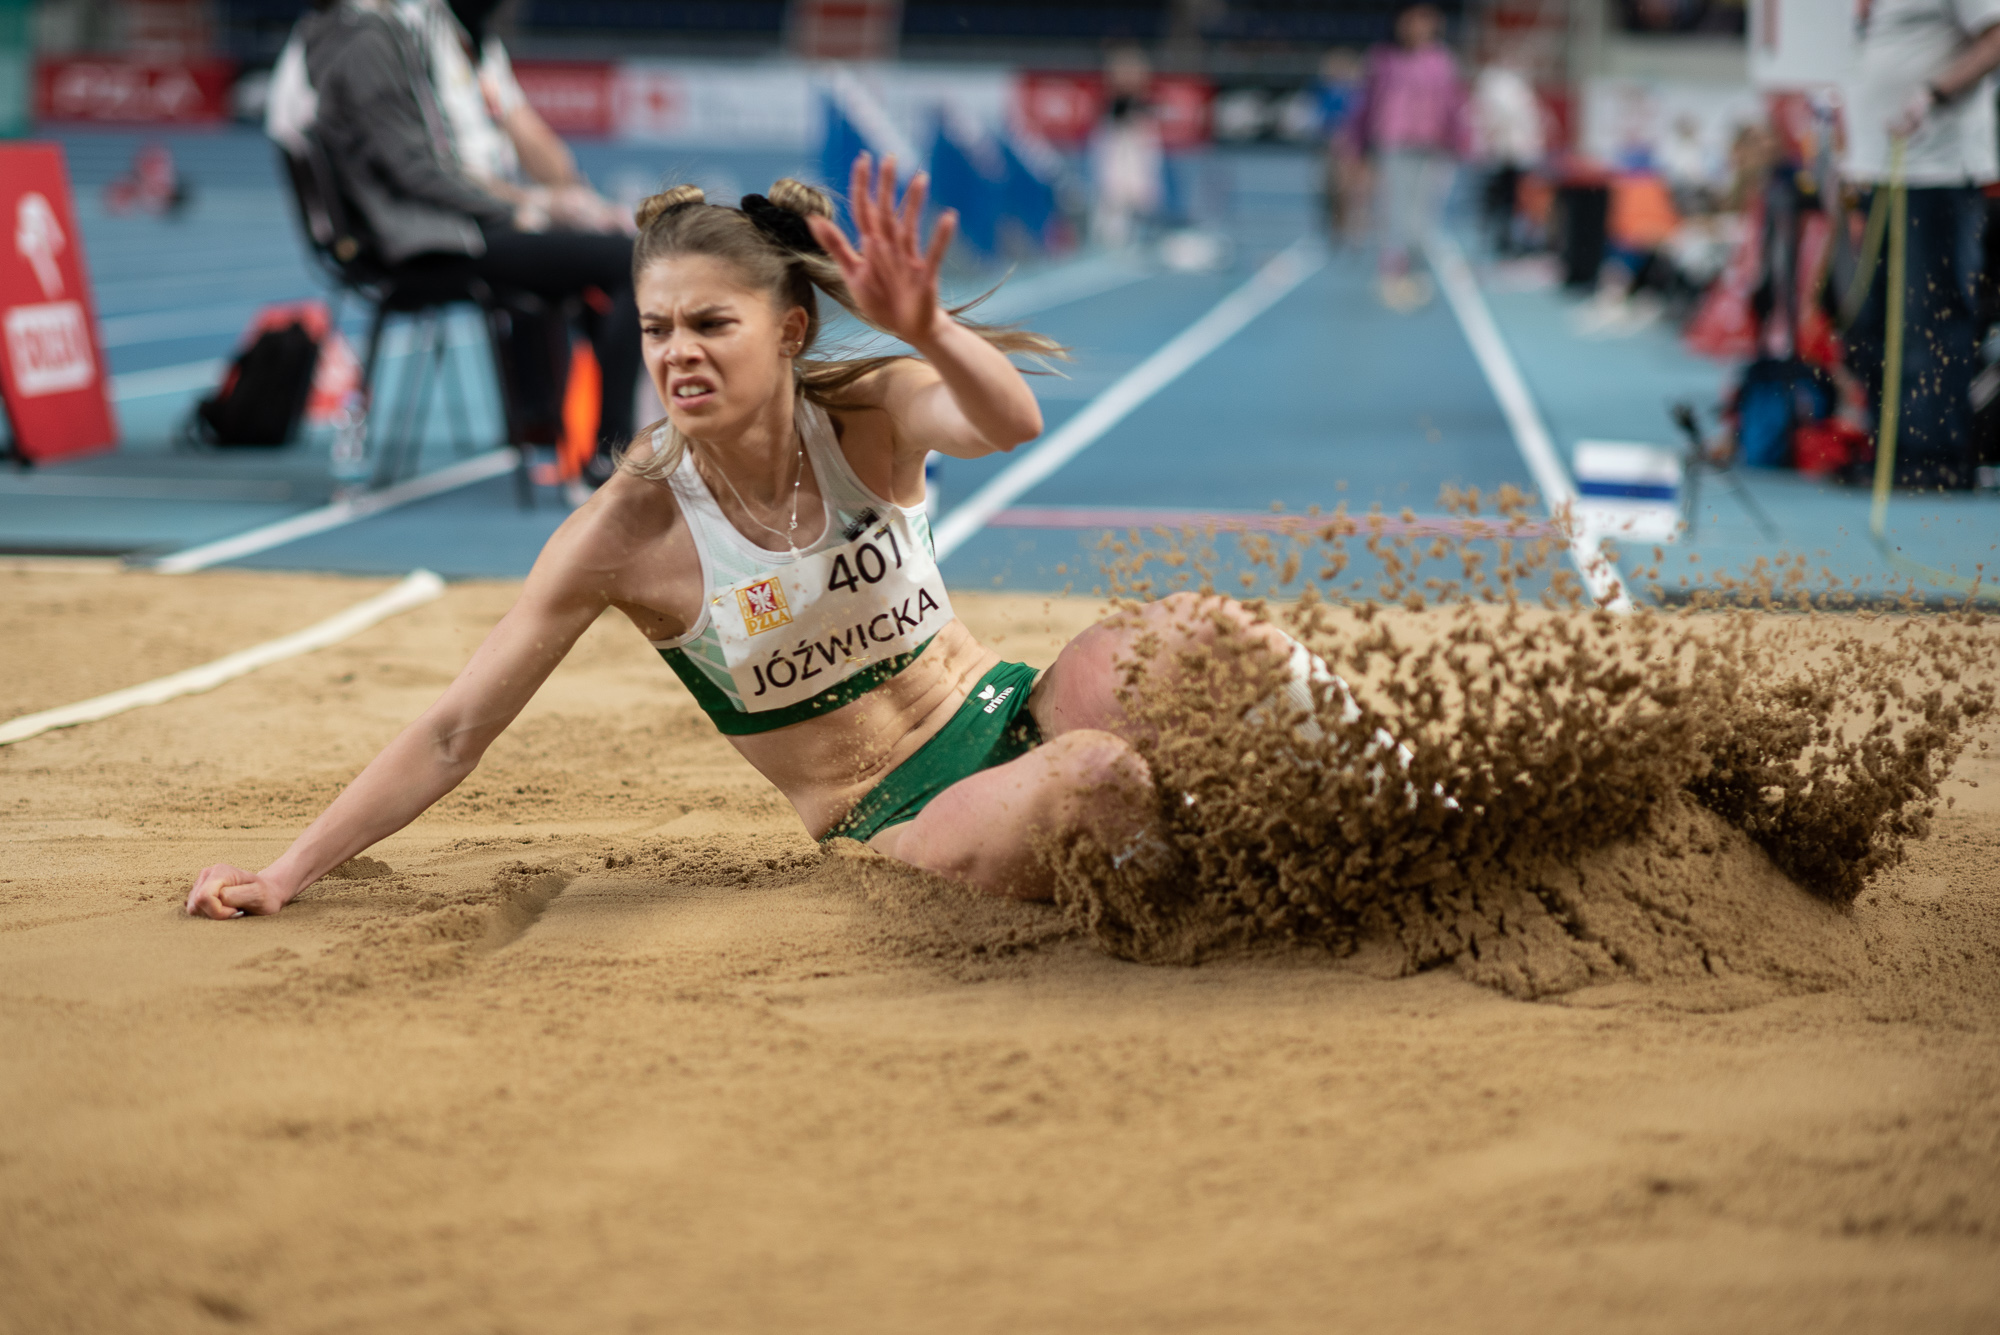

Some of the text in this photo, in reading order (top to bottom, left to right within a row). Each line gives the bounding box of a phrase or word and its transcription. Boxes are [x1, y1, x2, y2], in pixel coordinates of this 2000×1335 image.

[828, 523, 902, 593] 407
[747, 609, 790, 633] PZLA
[752, 587, 940, 696] JÓŹWICKA
[983, 686, 1015, 714] erima
